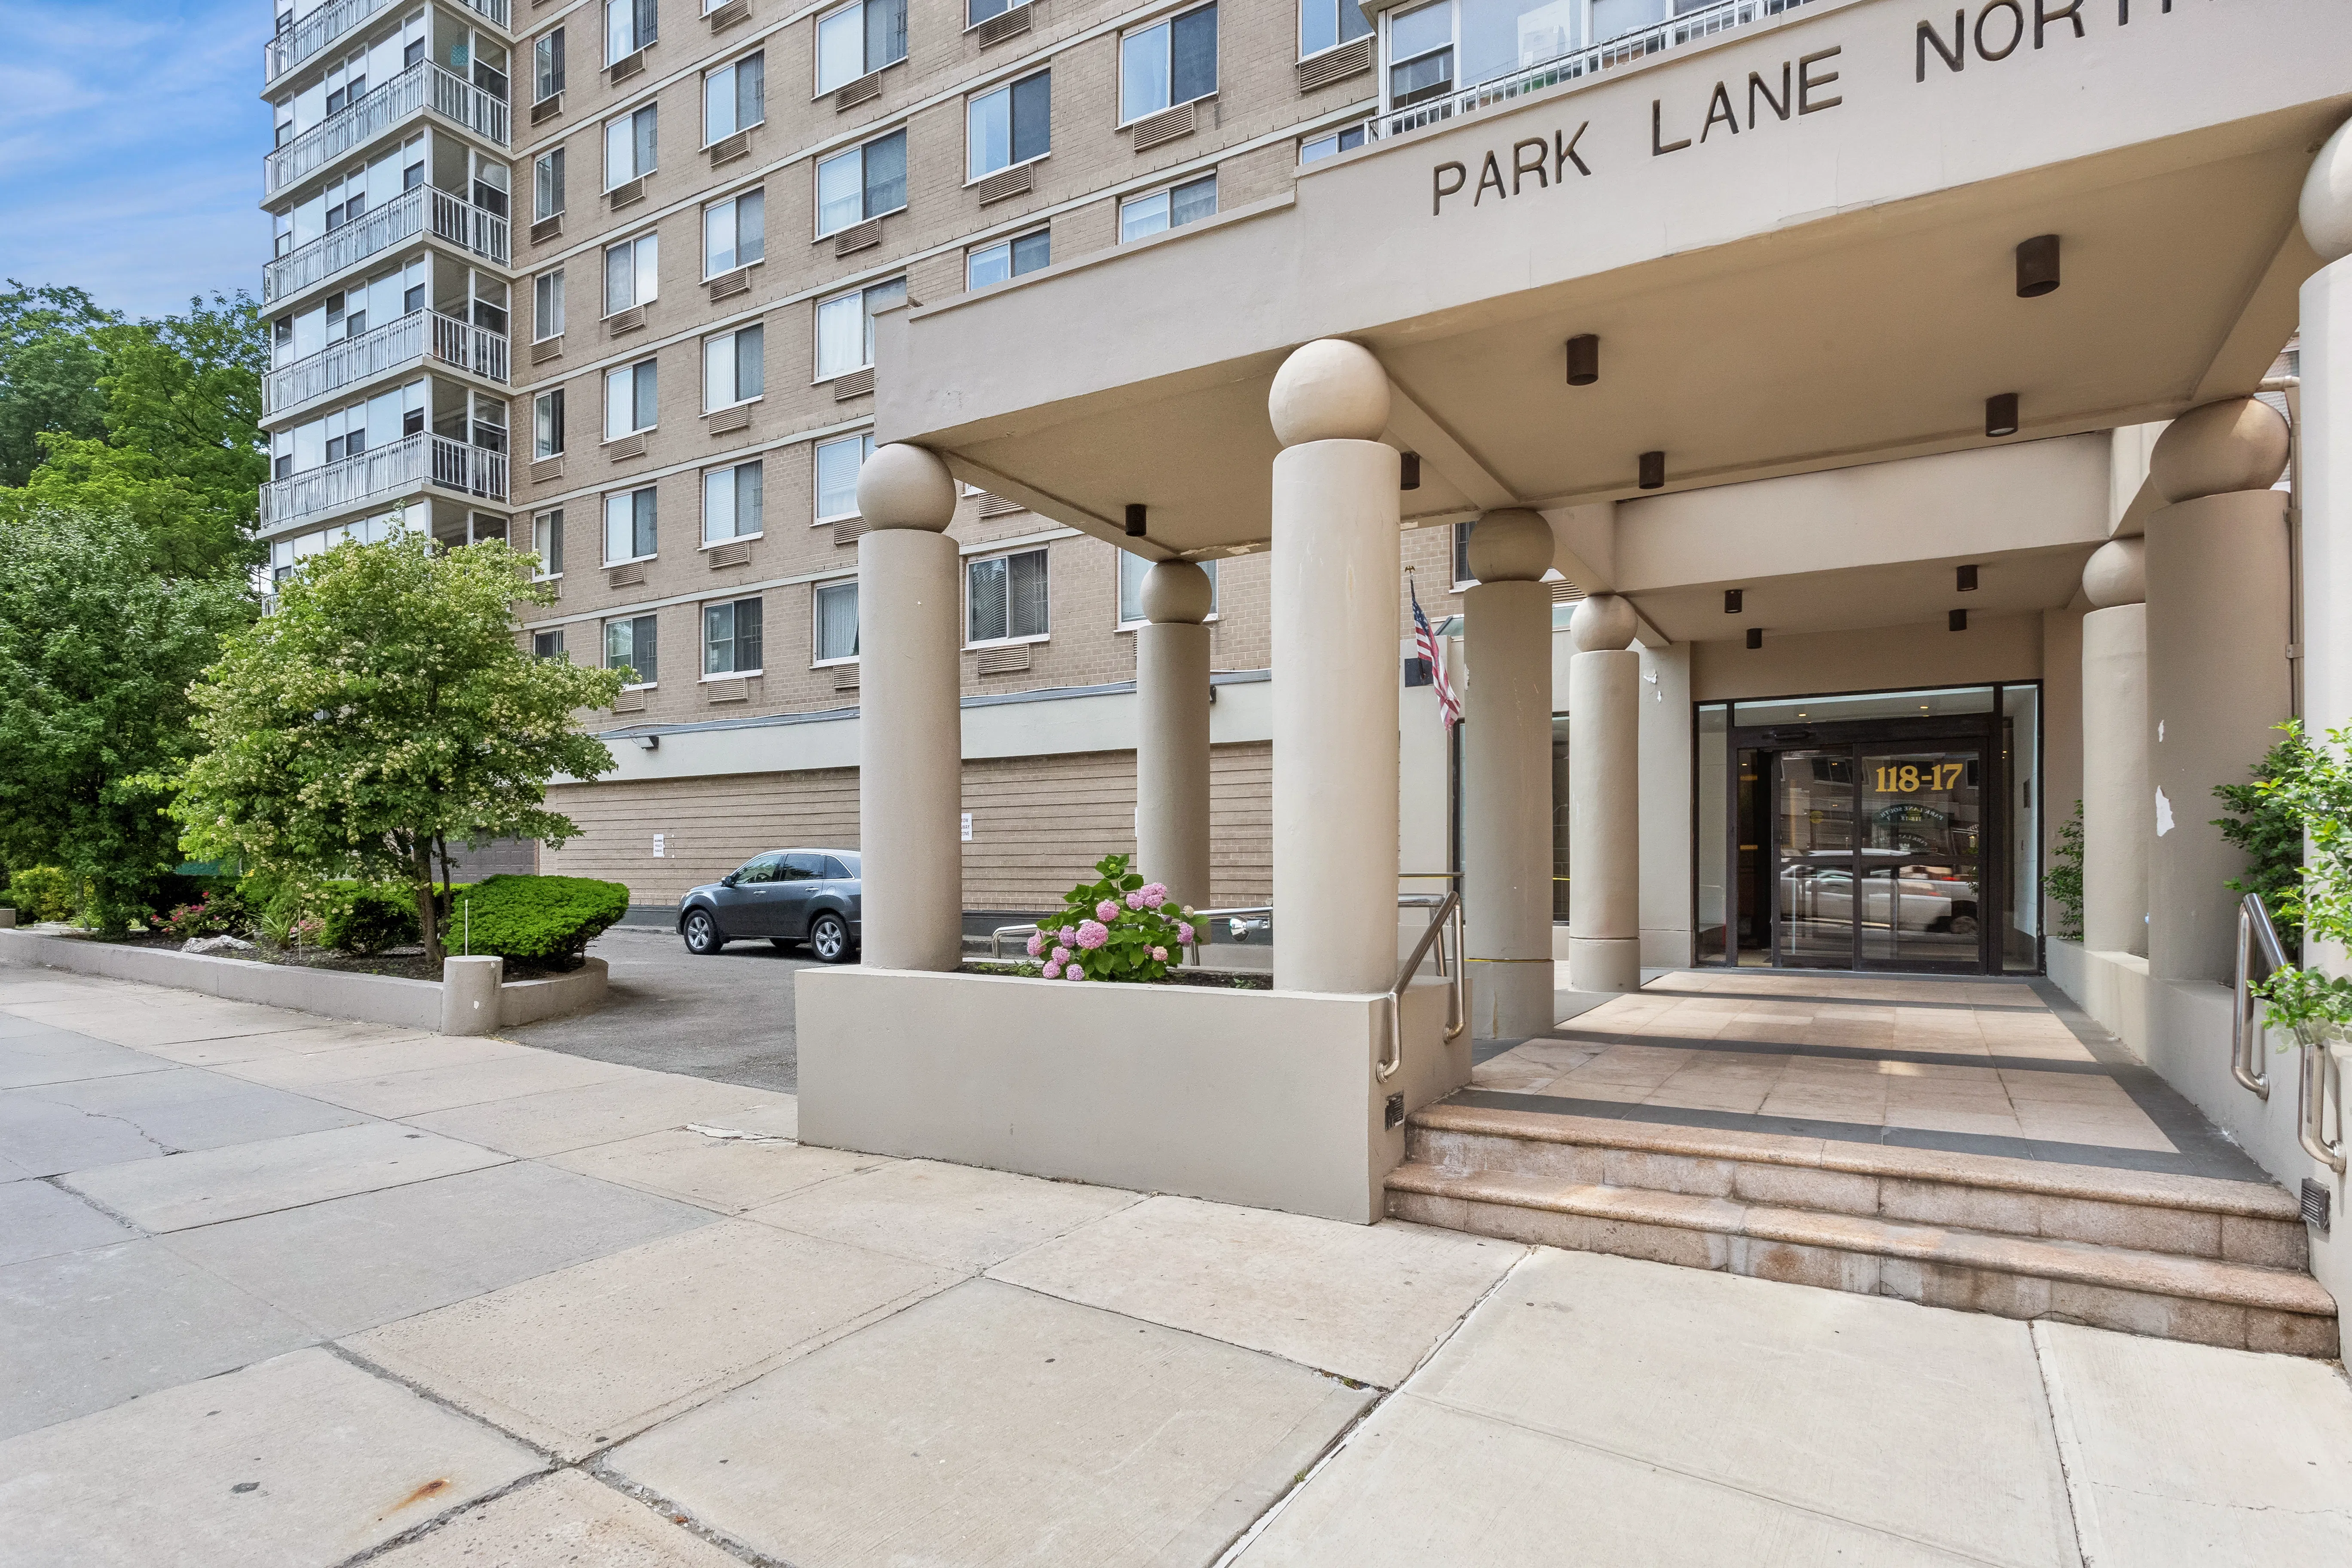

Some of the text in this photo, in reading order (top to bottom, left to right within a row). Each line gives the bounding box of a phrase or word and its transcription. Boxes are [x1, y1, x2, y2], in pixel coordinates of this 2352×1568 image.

[1433, 0, 2172, 216] PARK LANE NOR
[1875, 763, 1963, 792] 118-17
